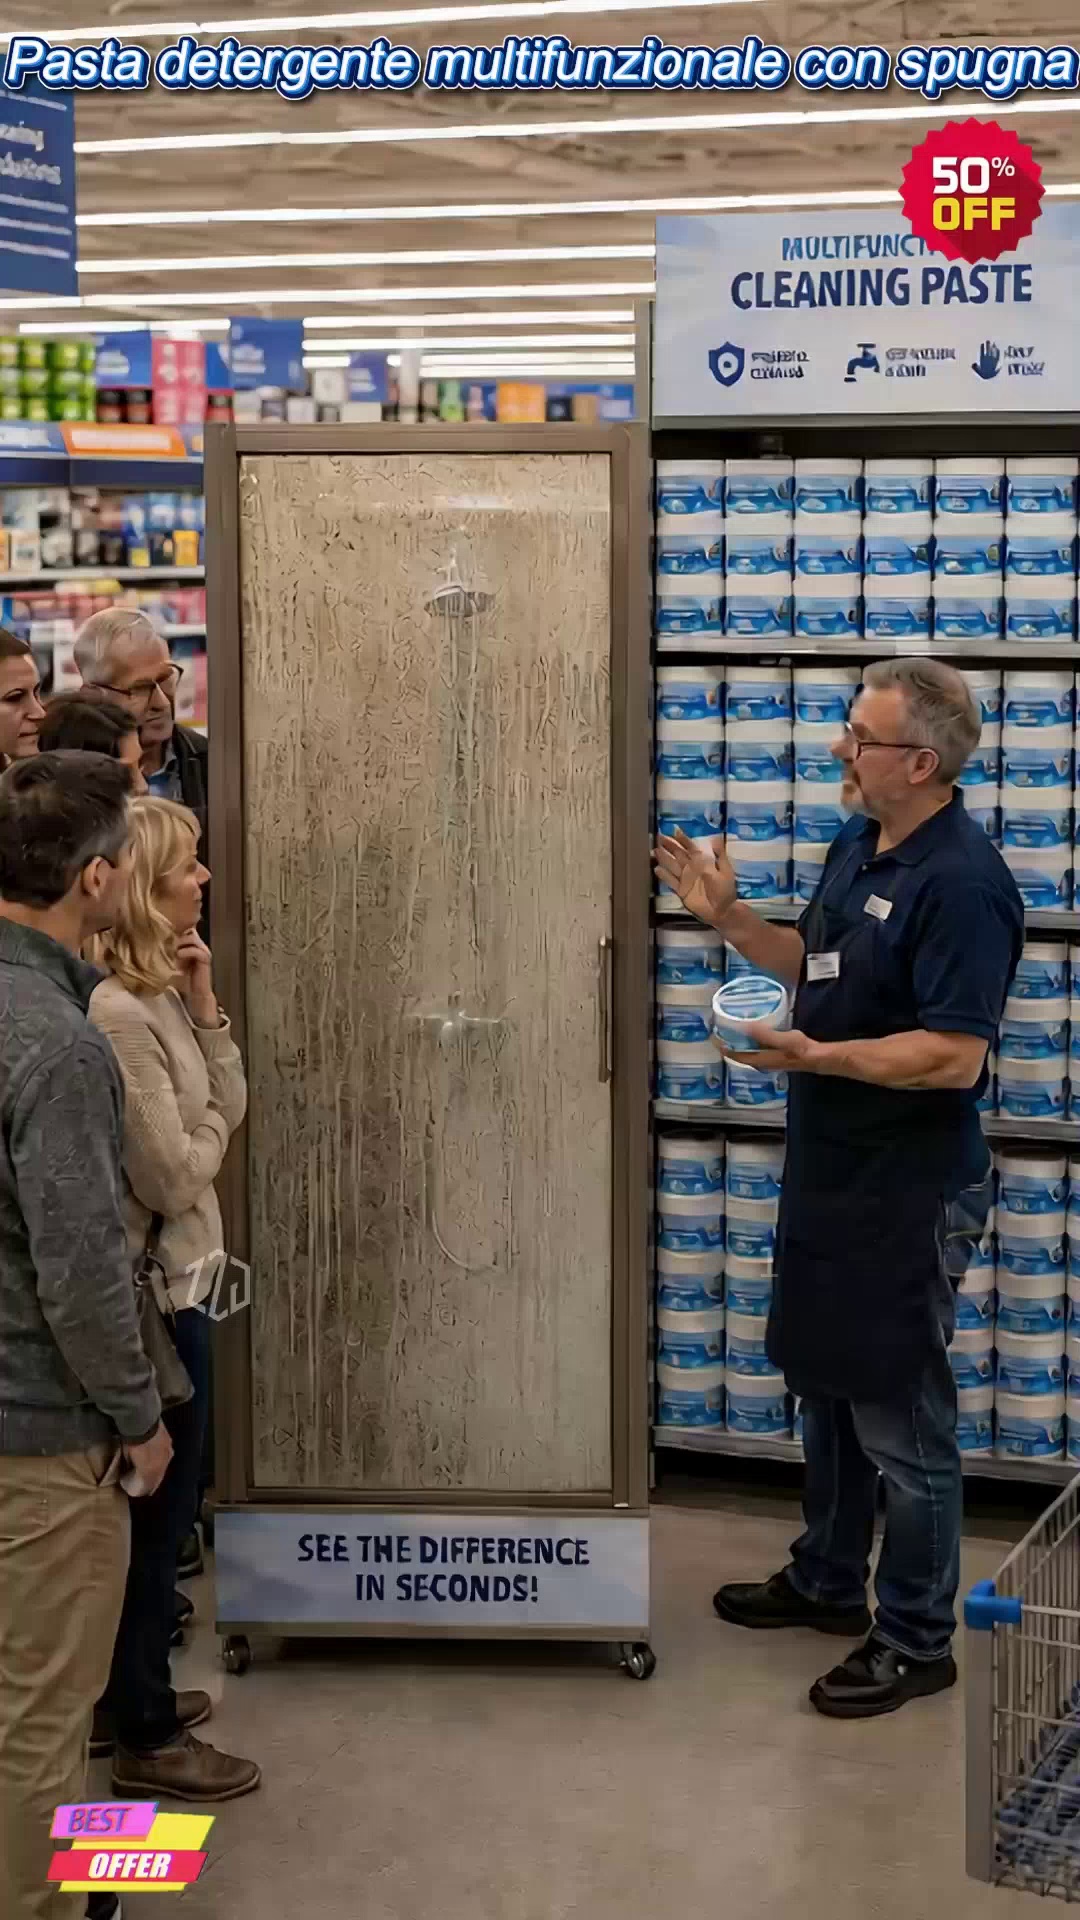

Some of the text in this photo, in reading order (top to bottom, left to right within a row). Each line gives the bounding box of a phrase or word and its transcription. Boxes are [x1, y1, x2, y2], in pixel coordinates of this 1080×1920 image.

[731, 264, 1032, 310] CLEANING PASTE
[297, 1534, 590, 1565] SEE THE DIFFERENCE
[355, 1574, 539, 1603] IN SECONDS!
